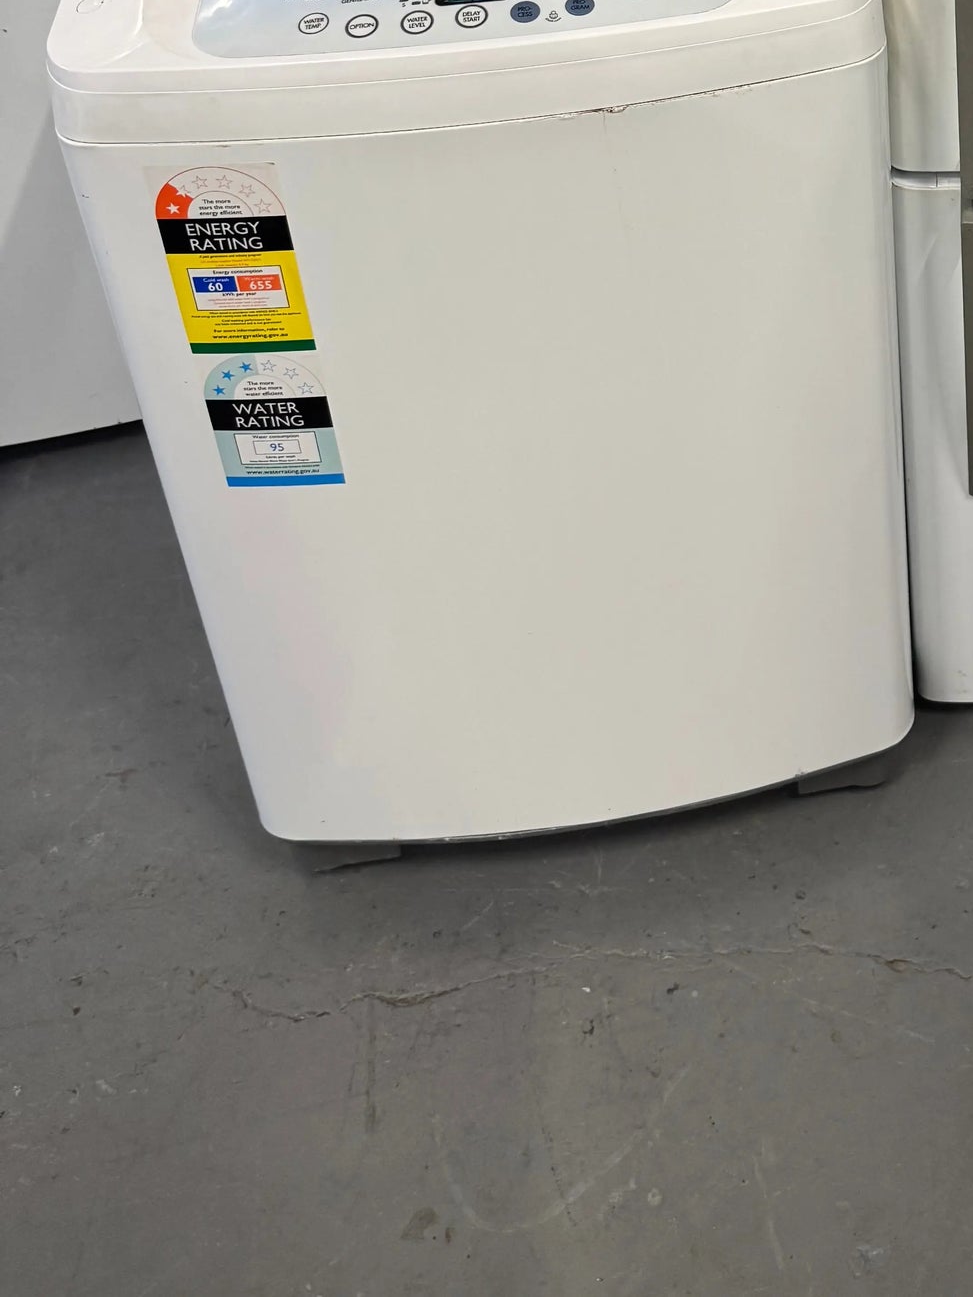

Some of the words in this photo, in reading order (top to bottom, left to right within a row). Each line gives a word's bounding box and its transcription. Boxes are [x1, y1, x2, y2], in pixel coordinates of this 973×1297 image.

[349, 22, 375, 31] OPTION
[185, 221, 260, 237] ENERGY
[189, 236, 264, 251] RATING
[207, 282, 224, 292] 60
[249, 280, 273, 290] 655
[232, 401, 300, 415] WATER
[235, 414, 305, 428] RATING
[269, 443, 285, 452] 95
